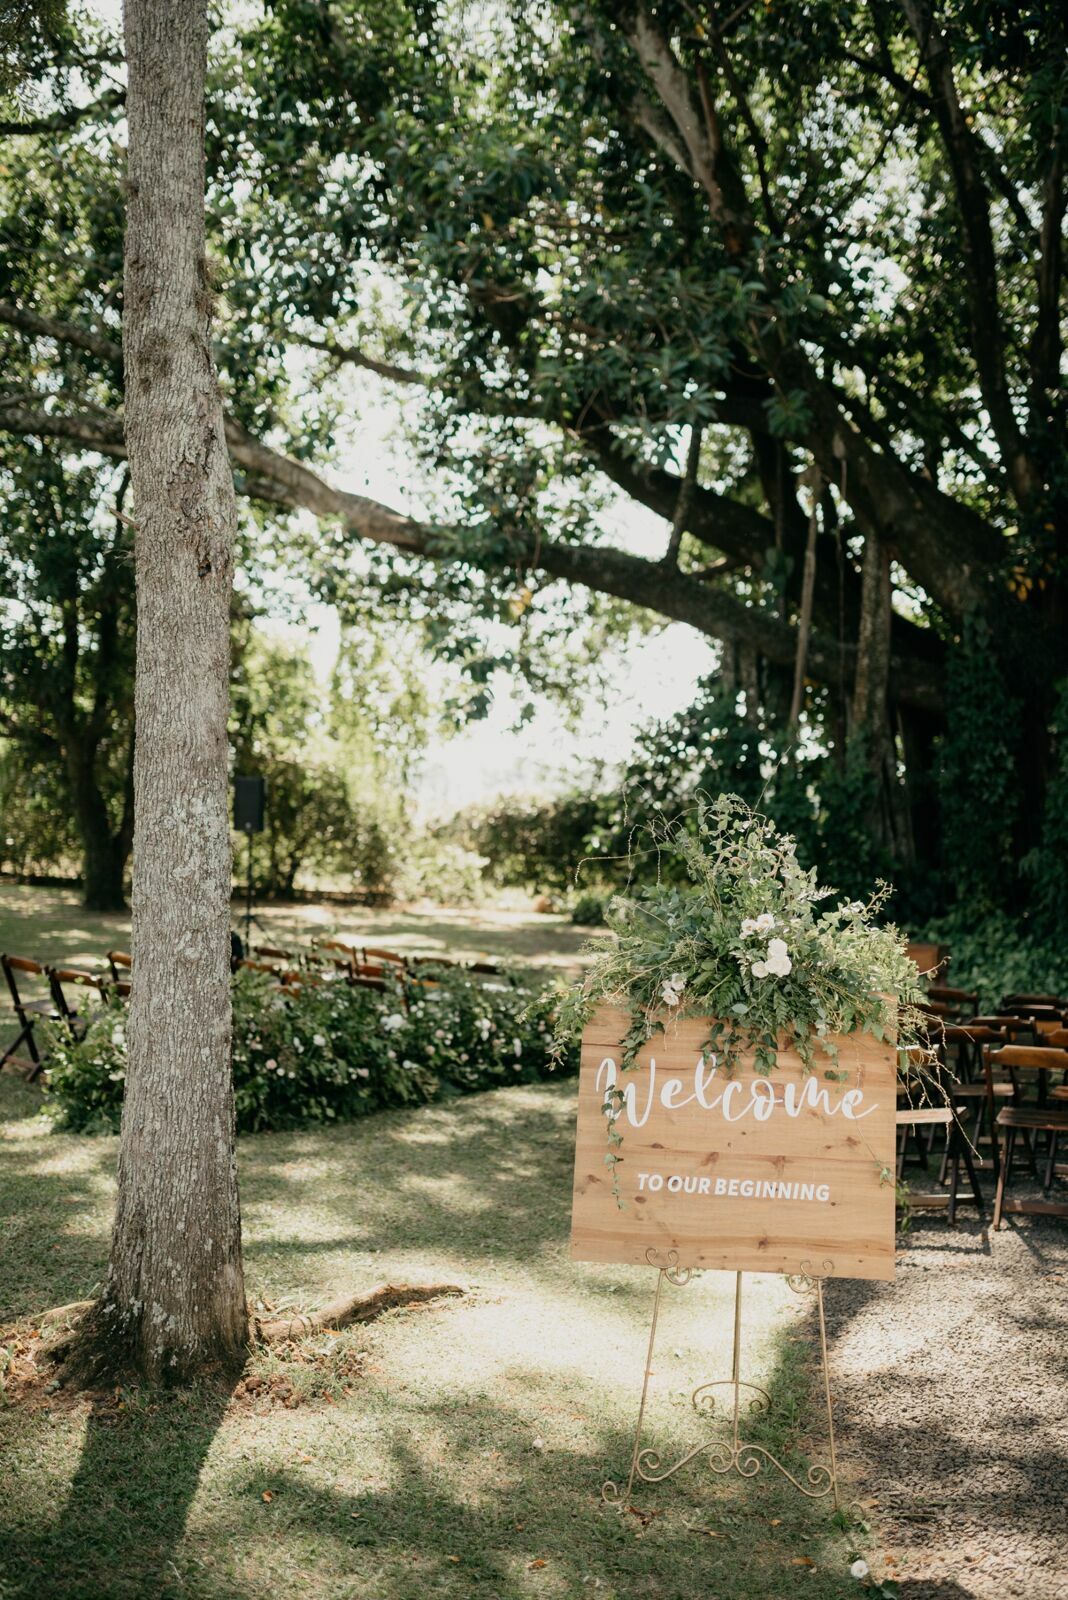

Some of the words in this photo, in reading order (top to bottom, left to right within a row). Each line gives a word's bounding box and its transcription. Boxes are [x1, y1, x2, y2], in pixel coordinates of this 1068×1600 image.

[595, 1054, 879, 1128] Welcome
[637, 1173, 667, 1192] TO
[667, 1175, 711, 1195] OUR
[714, 1178, 831, 1202] BEGINNING
